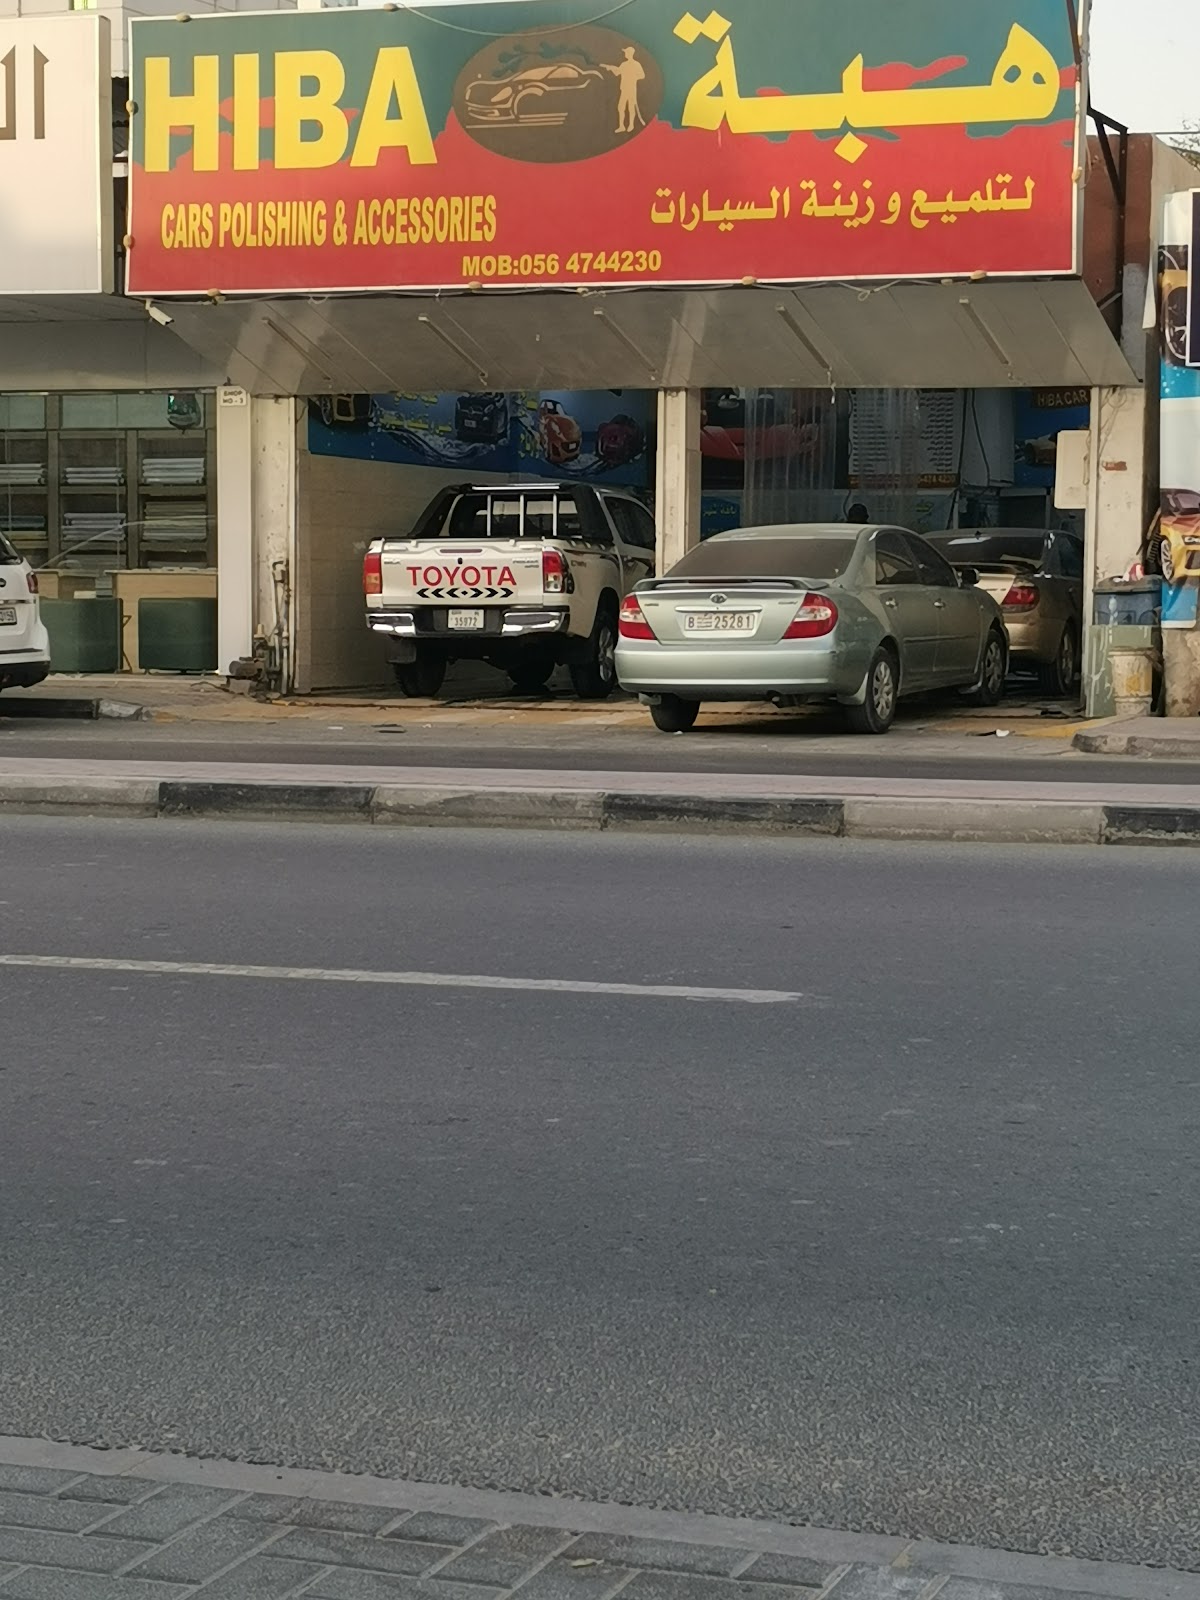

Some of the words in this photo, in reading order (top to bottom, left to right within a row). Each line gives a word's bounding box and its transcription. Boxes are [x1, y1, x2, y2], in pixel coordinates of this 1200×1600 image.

[673, 10, 1062, 164] هبة
[142, 46, 437, 176] HIBA
[160, 201, 214, 250] CARS
[216, 198, 328, 248] POLISHING
[333, 199, 348, 247] &
[353, 194, 498, 246] ACCESSORIES
[650, 187, 791, 232] السيارات
[800, 179, 876, 229] زينة
[882, 191, 902, 226] و
[909, 173, 1035, 229] لتلميع
[461, 252, 560, 278] MOB:056
[565, 249, 662, 275] 4744230
[406, 566, 517, 587] TOYOTA
[687, 616, 695, 628] B
[714, 615, 751, 628] 25281
